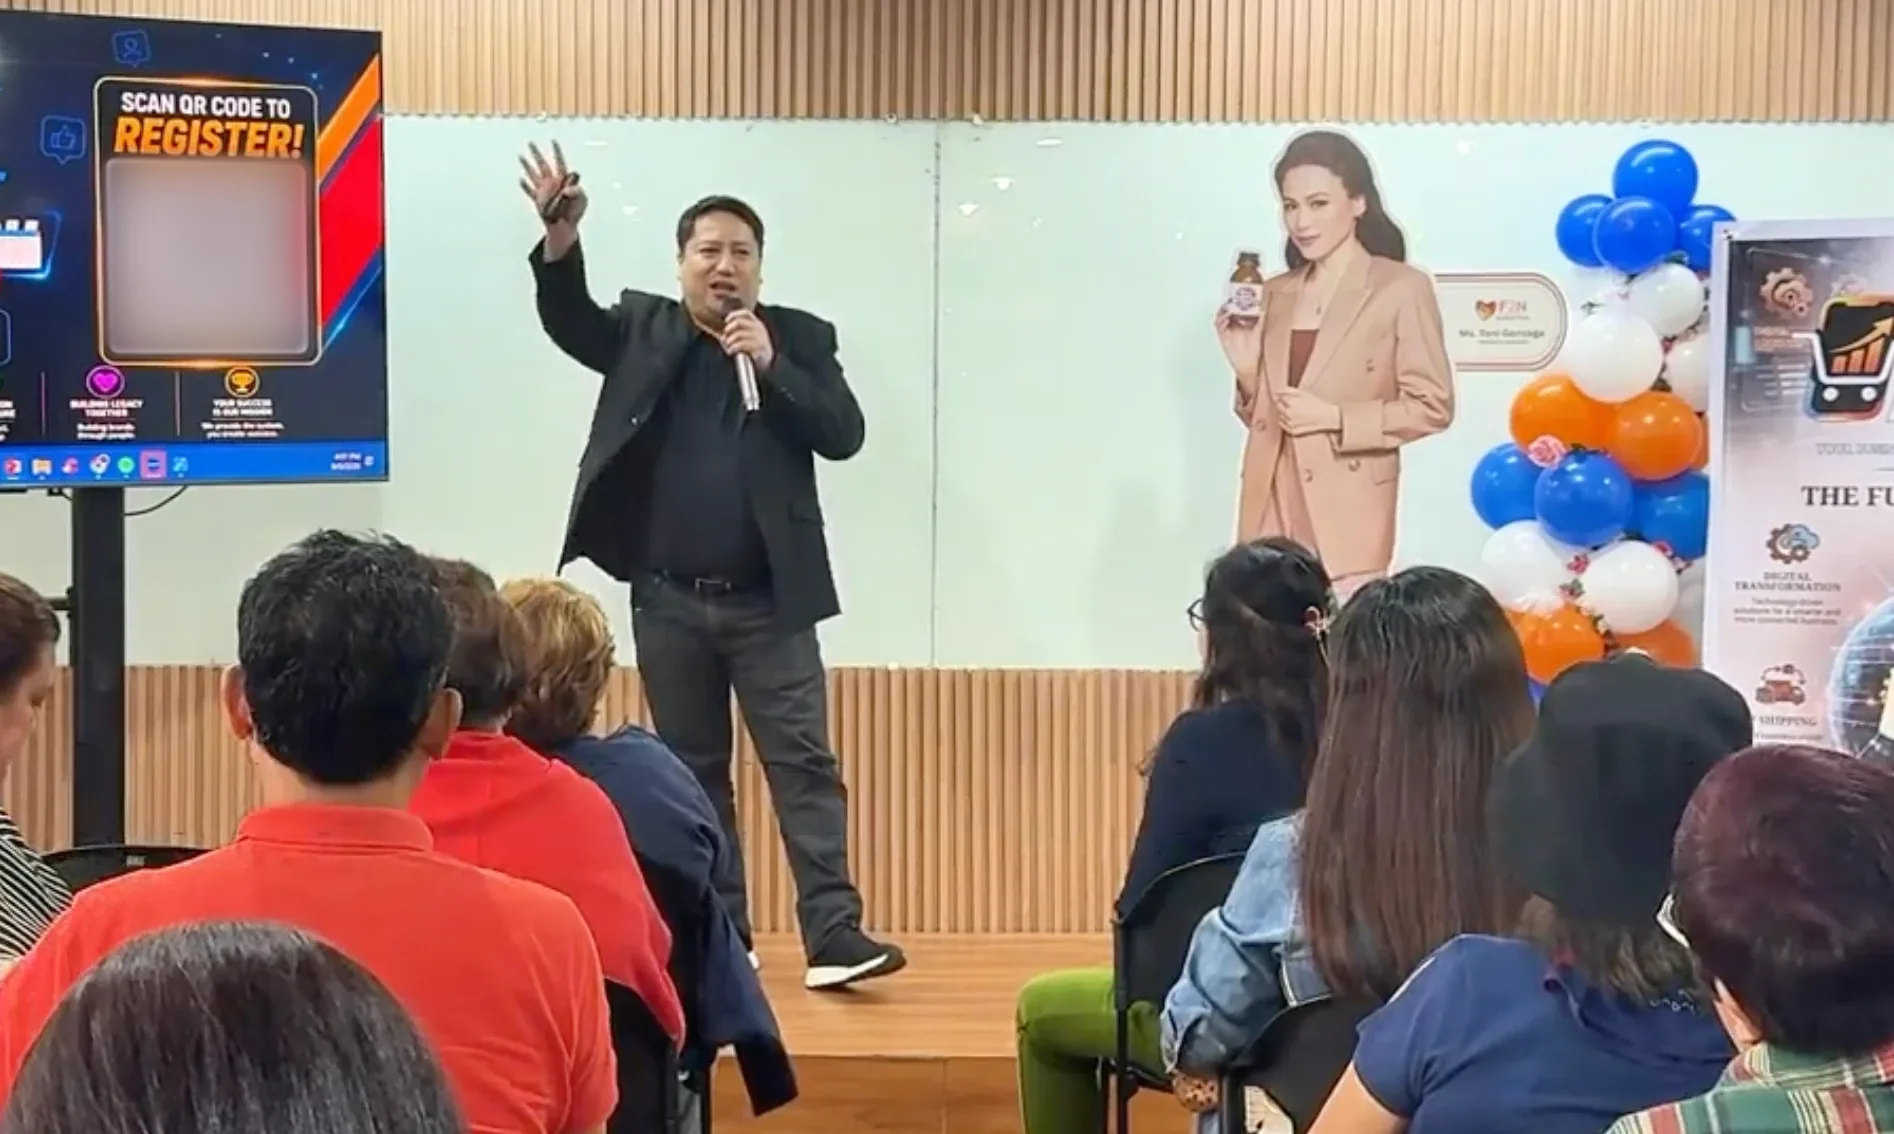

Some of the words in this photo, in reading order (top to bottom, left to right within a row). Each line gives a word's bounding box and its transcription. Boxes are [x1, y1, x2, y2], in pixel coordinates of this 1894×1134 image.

[121, 91, 175, 114] SCAN
[179, 94, 207, 116] QR
[211, 97, 263, 118] CODE
[266, 98, 291, 119] TO
[113, 116, 305, 159] REGISTER!
[111, 399, 143, 409] LEGACY
[85, 408, 129, 417] TOGETHER
[1801, 485, 1859, 506] THE
[1763, 572, 1811, 581] DIGITAL
[1735, 581, 1841, 592] TRANSFORMATION
[1758, 714, 1818, 728] SHIPPING
